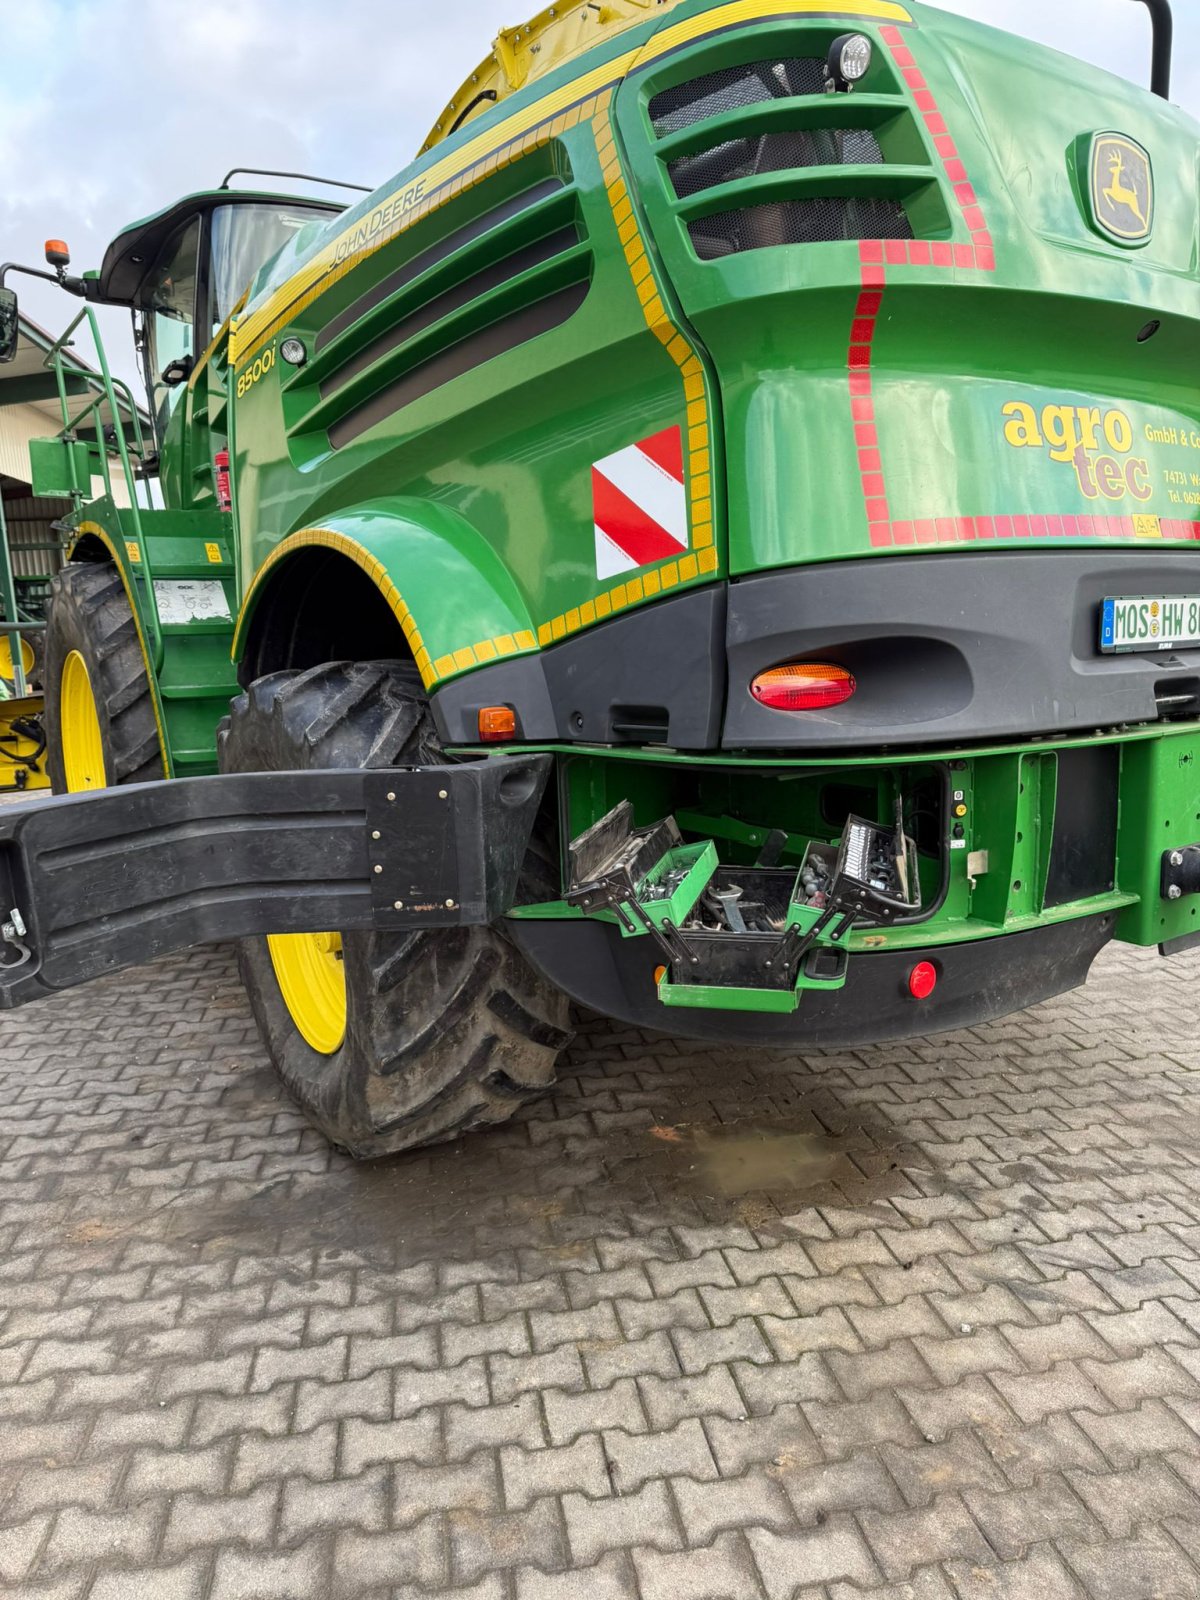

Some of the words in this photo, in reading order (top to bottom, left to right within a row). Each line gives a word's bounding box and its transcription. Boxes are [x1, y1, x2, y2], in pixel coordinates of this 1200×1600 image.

[237, 338, 276, 399] 8500i
[1002, 401, 1133, 463] agro
[1144, 423, 1178, 445] GmbH
[1181, 429, 1189, 447] &
[1073, 442, 1152, 501] tec
[1163, 470, 1187, 486] 74731
[1115, 604, 1149, 638] MOS
[1162, 603, 1184, 636] HW
[1188, 602, 1200, 635] 8
